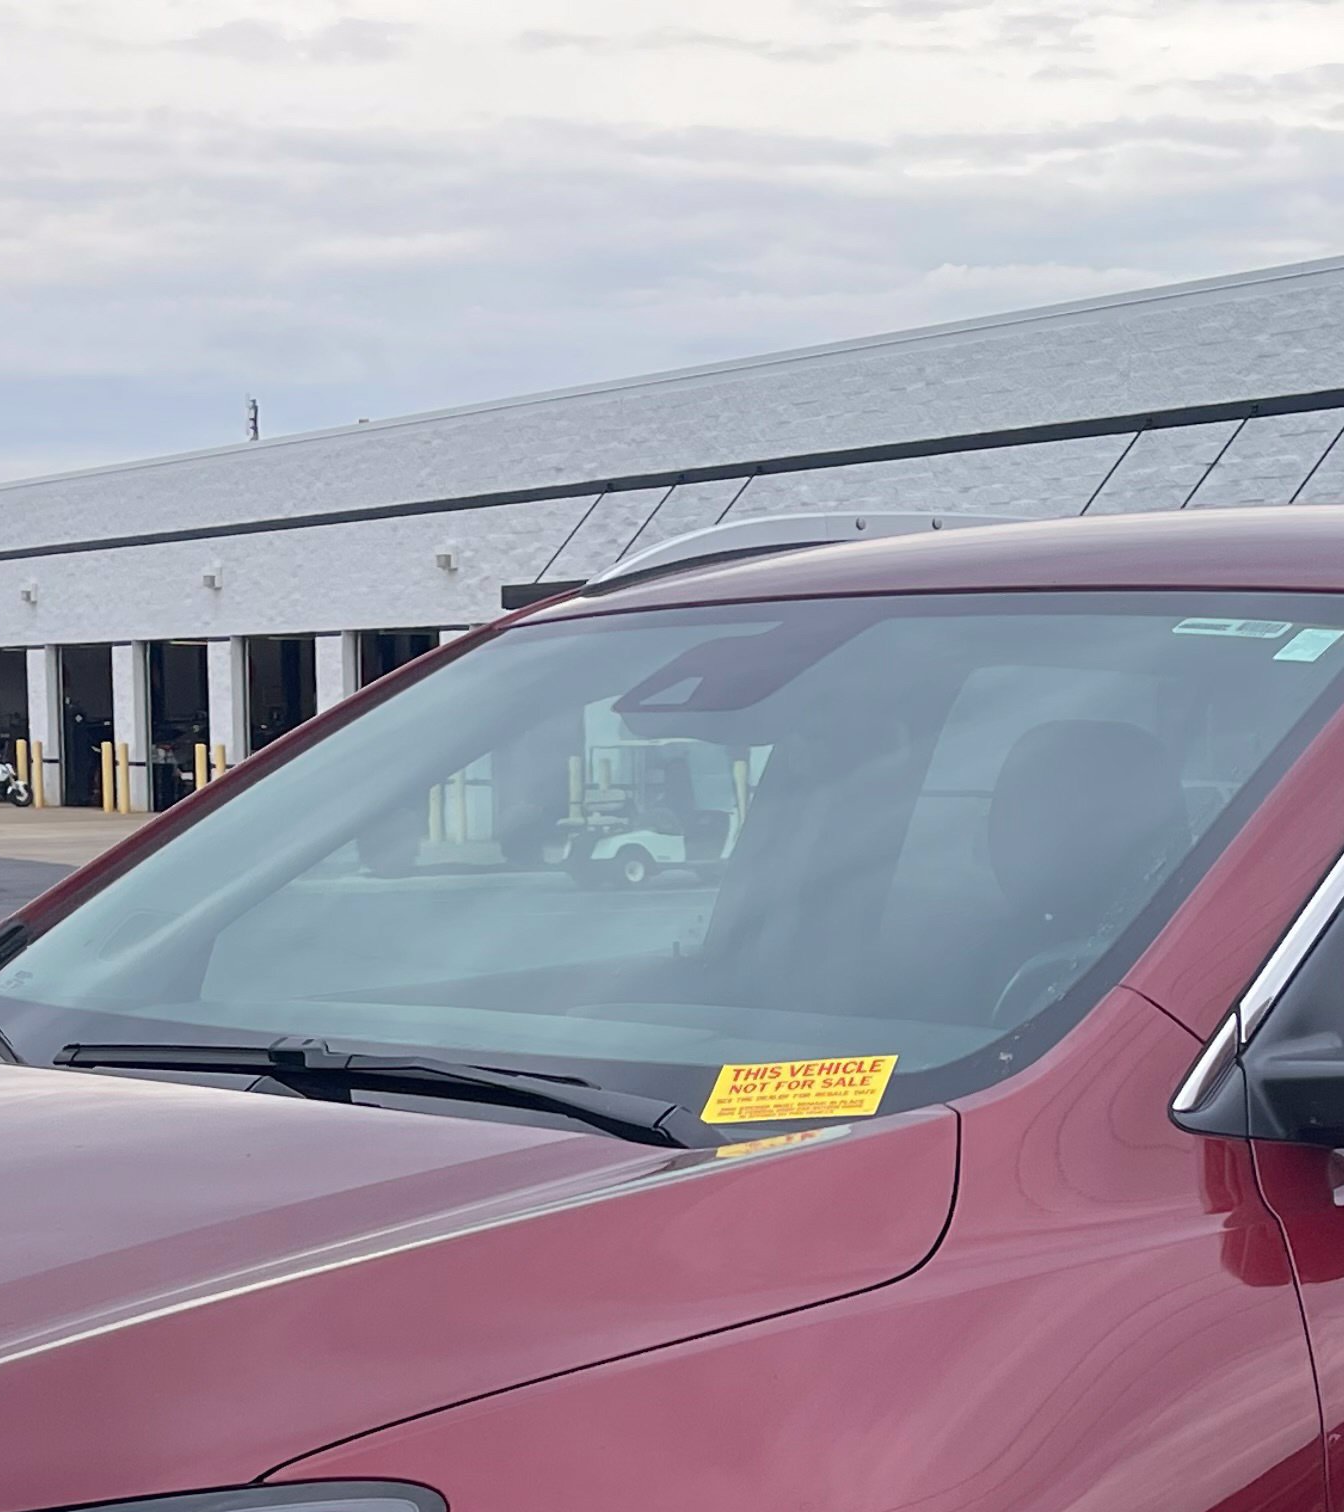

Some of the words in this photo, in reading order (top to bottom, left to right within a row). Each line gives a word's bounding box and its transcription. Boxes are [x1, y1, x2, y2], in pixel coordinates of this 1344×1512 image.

[732, 1067, 782, 1082] THIS
[789, 1059, 885, 1077] VEHICLE
[728, 1081, 771, 1095] NOT
[774, 1079, 815, 1092] FOR
[821, 1075, 873, 1089] SALE
